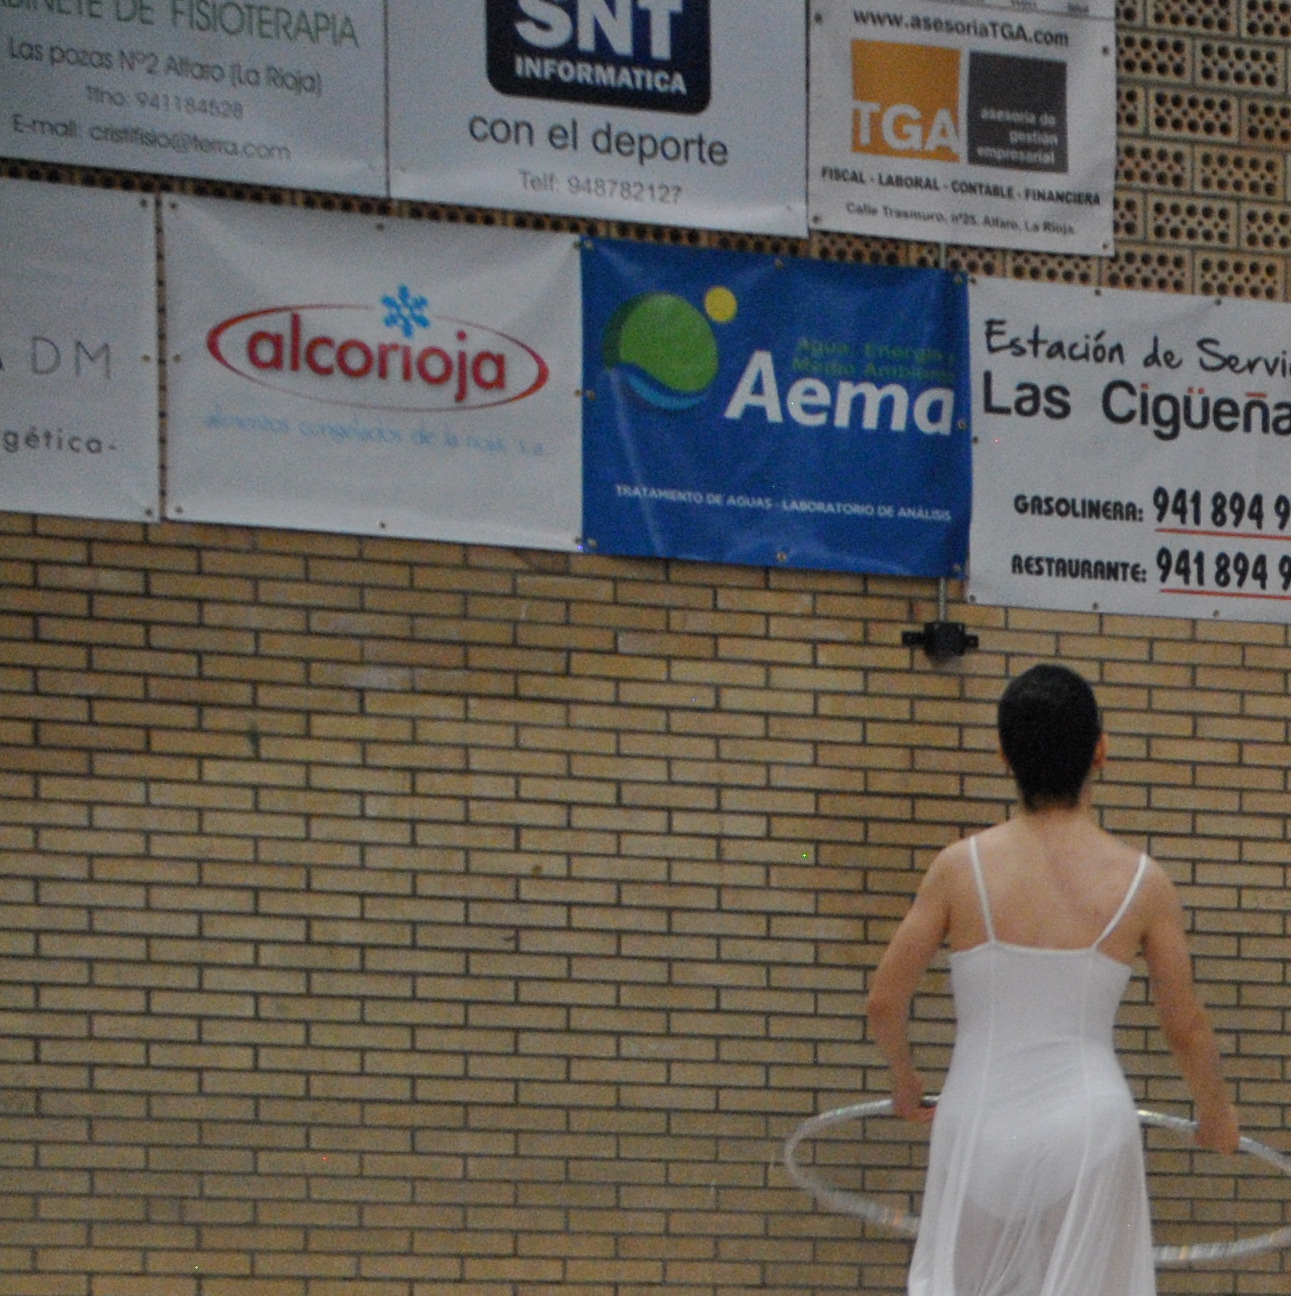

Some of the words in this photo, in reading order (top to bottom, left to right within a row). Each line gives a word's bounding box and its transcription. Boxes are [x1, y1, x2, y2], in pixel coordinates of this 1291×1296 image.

[8, 37, 43, 61] Las
[169, 0, 360, 49] FISIOTERAPIA
[515, 0, 684, 60] SNT
[853, 9, 1069, 47] www.asesoriaTGA.com
[514, 54, 688, 95] INFORMATICA
[468, 114, 535, 147] con
[548, 117, 578, 151] el
[591, 121, 729, 167] deporte
[852, 99, 960, 154] TGA
[821, 165, 866, 184] FISCAL
[877, 171, 940, 191] LABORAL
[951, 179, 1014, 200] CONTABLE
[1024, 186, 1101, 206] FINANCIERA
[247, 312, 507, 402] alcorioja
[984, 318, 1125, 366] Estación
[1142, 336, 1184, 370] de
[724, 349, 955, 436] Aema
[983, 369, 1072, 421] Las
[616, 484, 703, 505] TRATAMIENTO
[705, 493, 723, 506] DE
[726, 495, 773, 510] AGUAS
[782, 500, 875, 516] LABORATORIO
[877, 506, 895, 518] DE
[1013, 493, 1144, 523] GASOLINERA:
[1153, 485, 1202, 527] 941
[1211, 490, 1265, 532] 894
[1011, 553, 1148, 584] RESTAURANTE:
[1156, 546, 1205, 587] 941
[1214, 551, 1268, 591] 894
